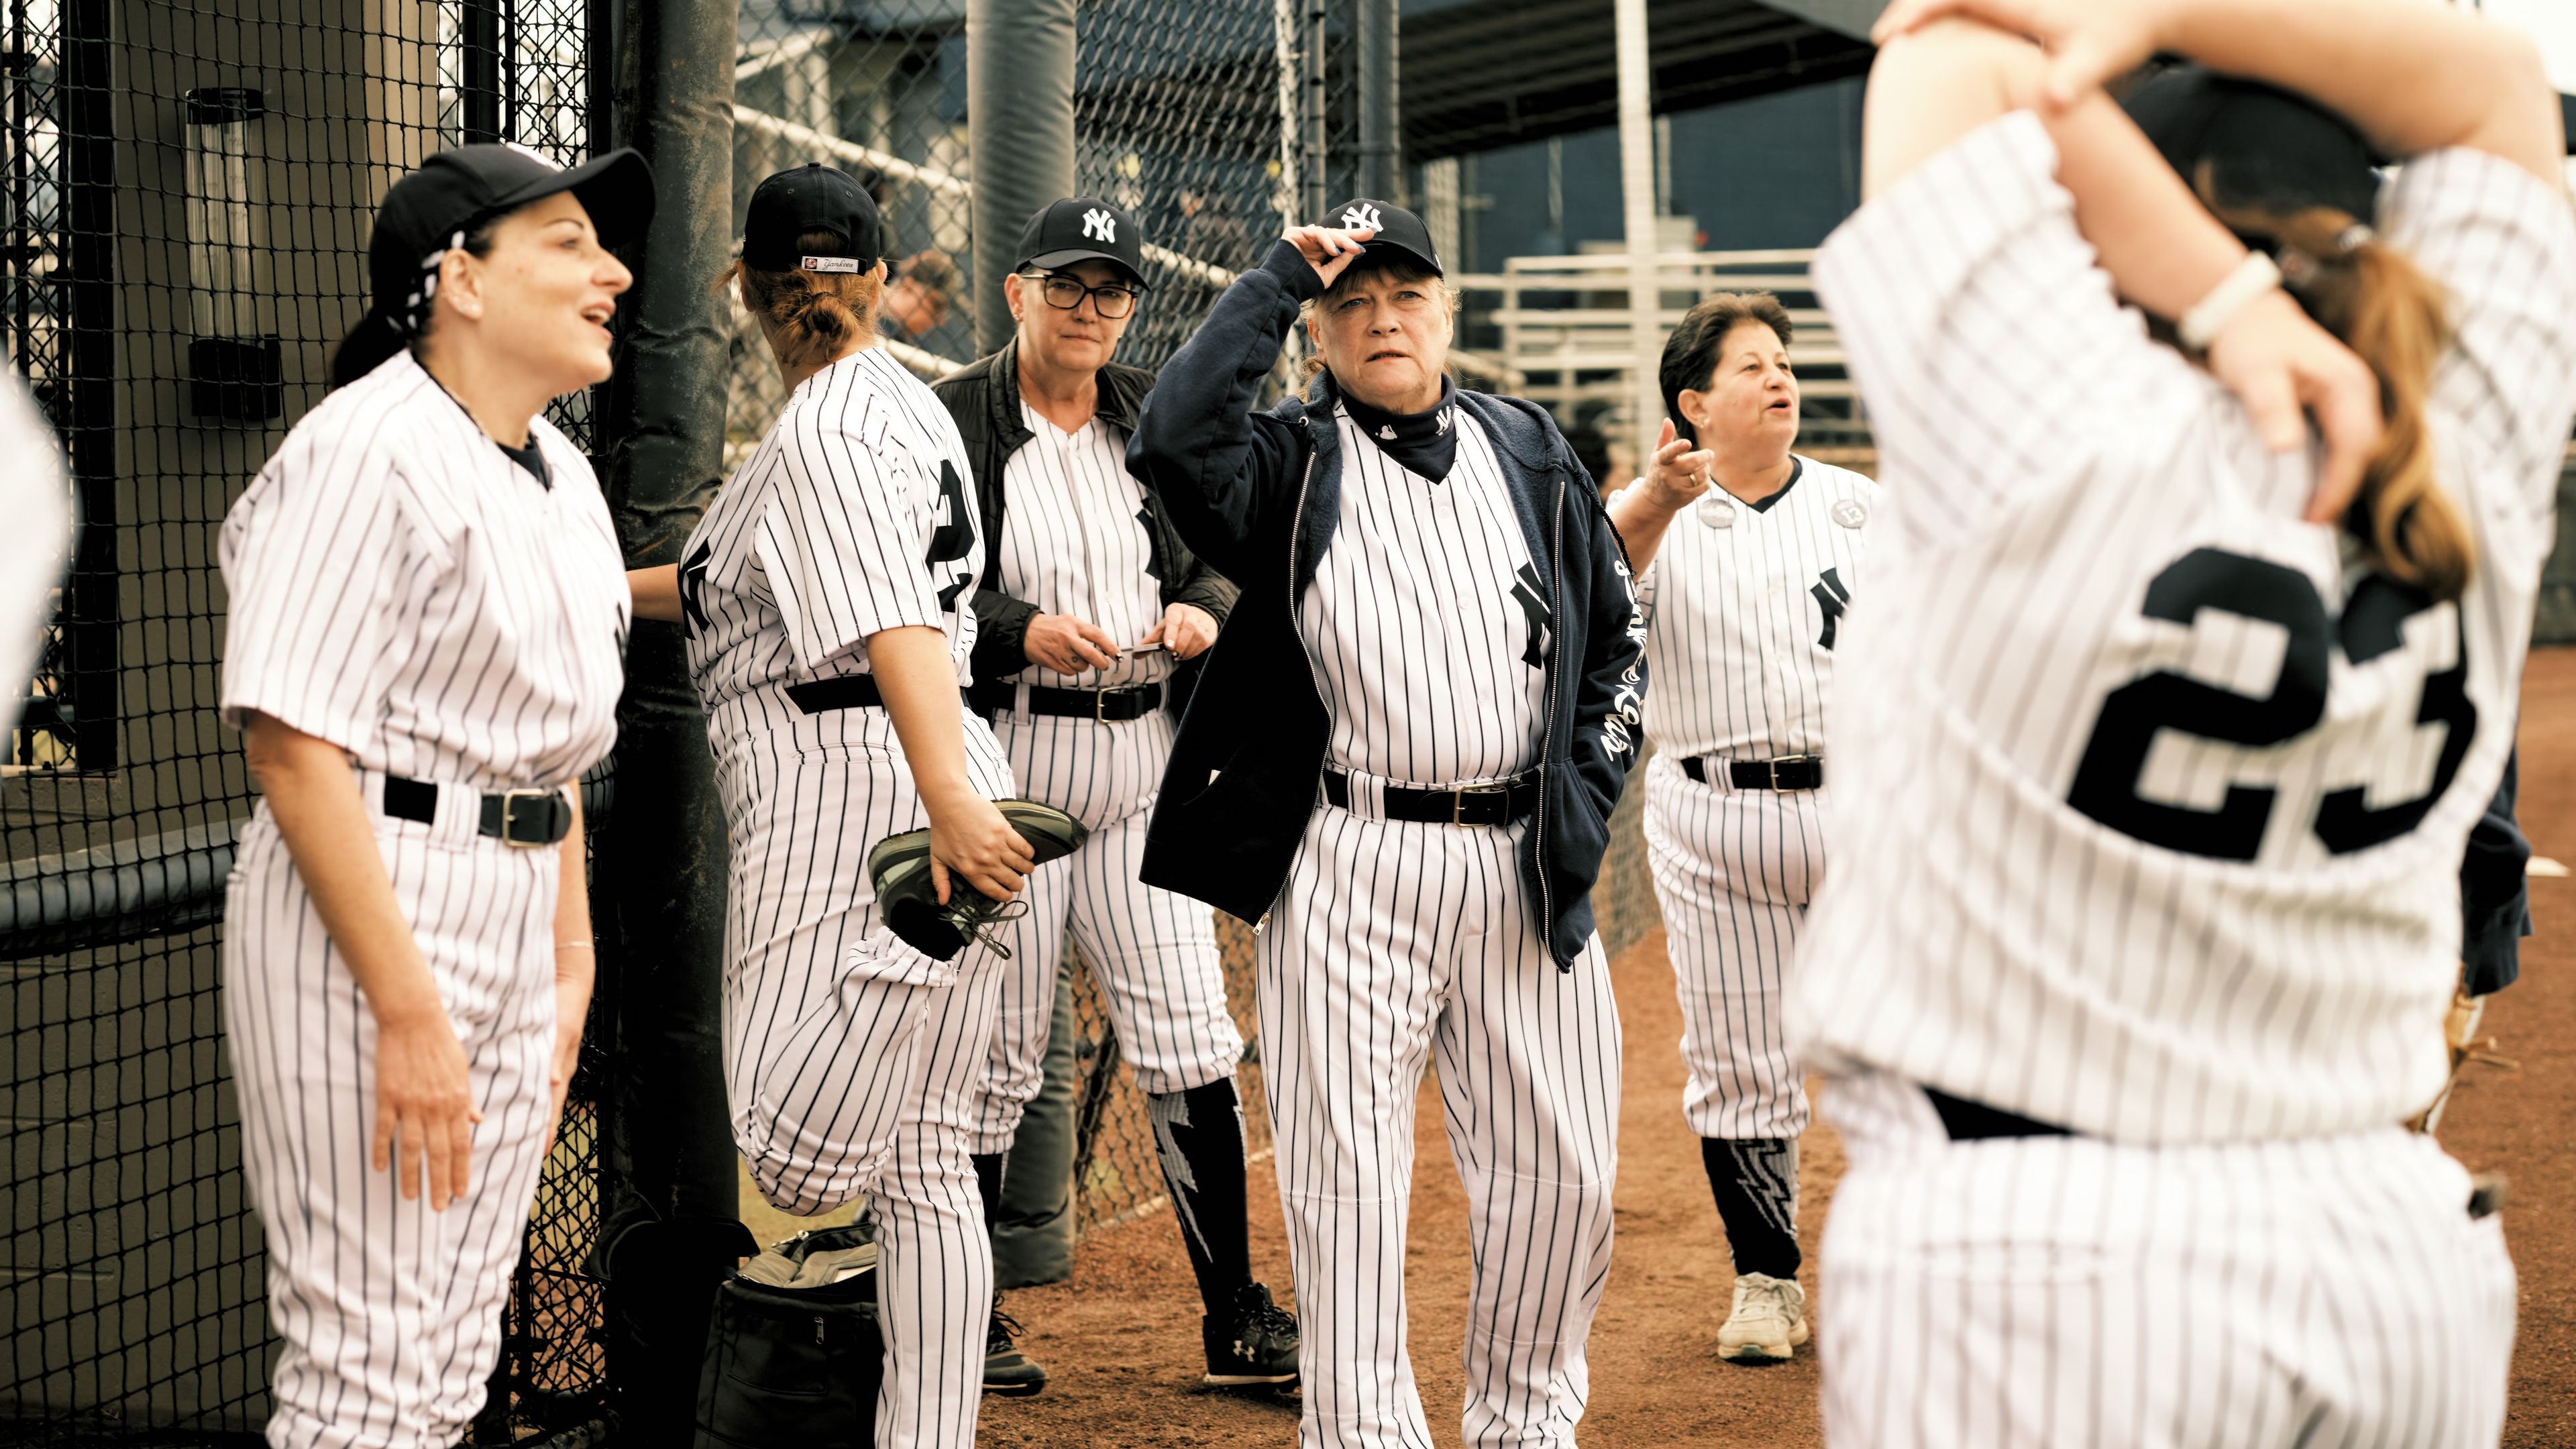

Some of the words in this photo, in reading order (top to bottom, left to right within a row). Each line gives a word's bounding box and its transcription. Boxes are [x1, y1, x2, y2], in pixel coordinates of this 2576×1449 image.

[1082, 208, 1116, 244] NY
[1341, 203, 1384, 233] NY
[823, 259, 854, 270] Yankees
[1841, 506, 1865, 525] 13
[2066, 547, 2477, 863] 23
